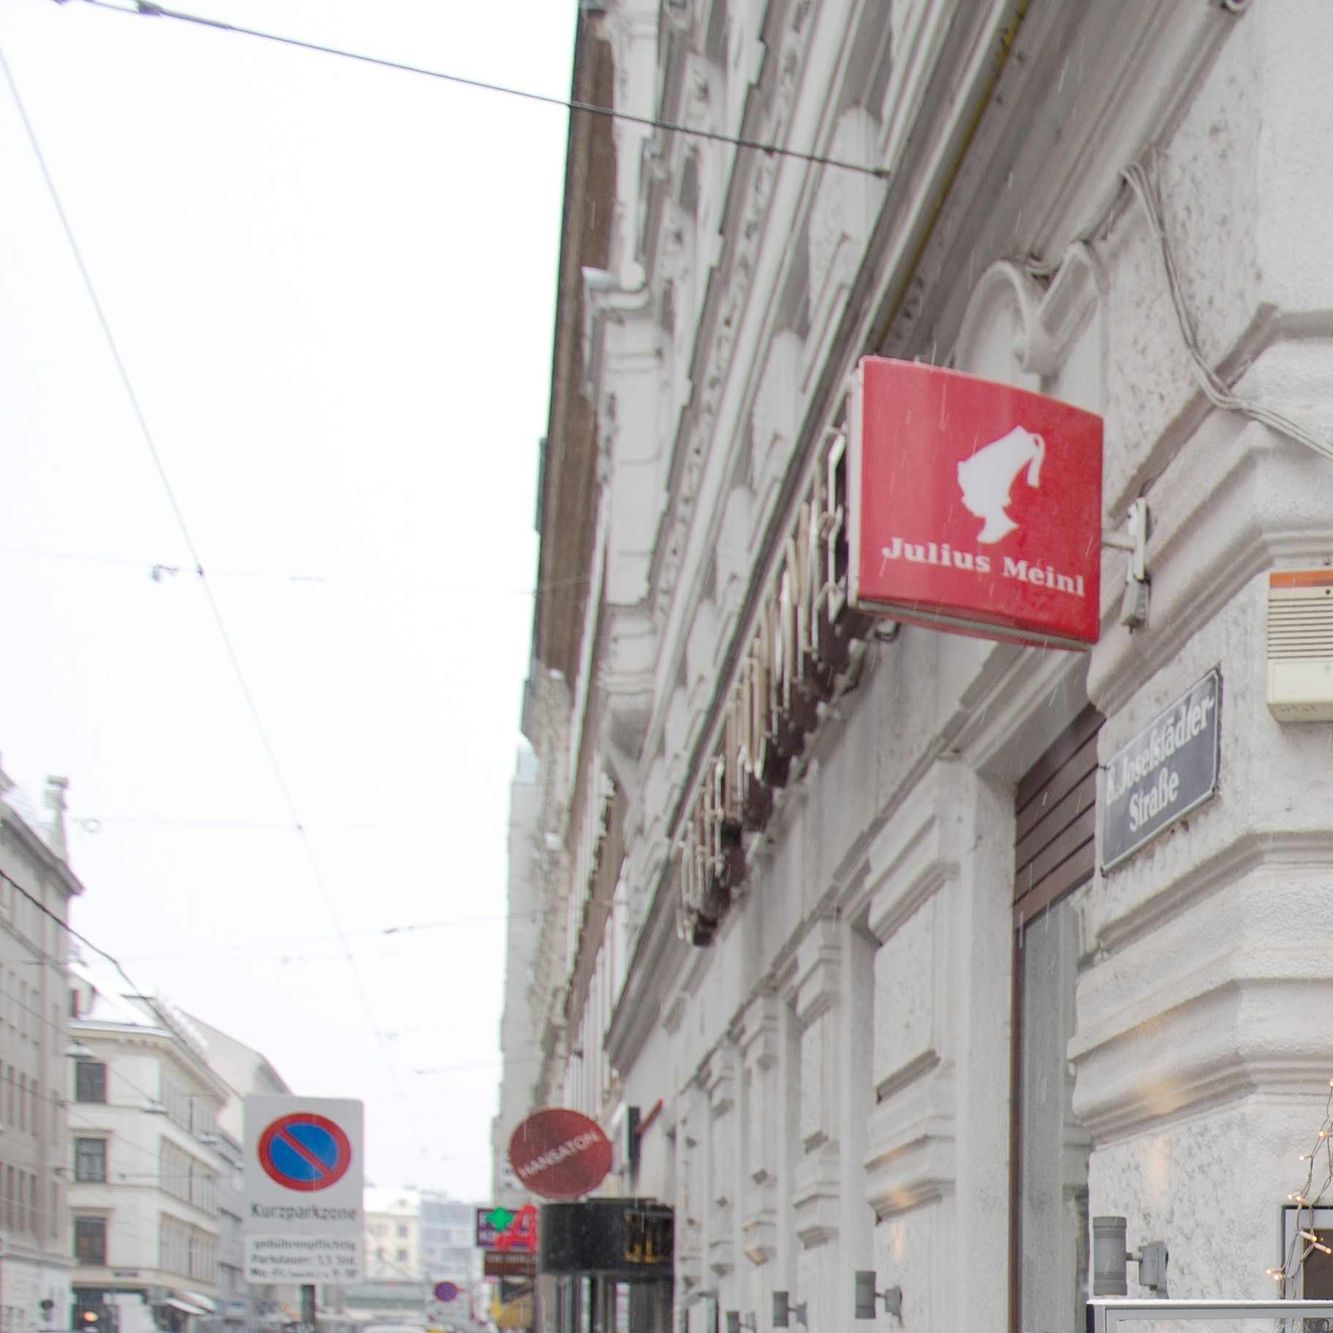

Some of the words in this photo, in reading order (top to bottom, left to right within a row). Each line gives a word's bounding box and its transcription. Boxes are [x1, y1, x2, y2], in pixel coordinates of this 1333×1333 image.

[881, 536, 991, 573] Julius
[1002, 555, 1086, 597] Meinl
[1128, 766, 1180, 833] Straße
[250, 1202, 358, 1222] Kurzparkzone
